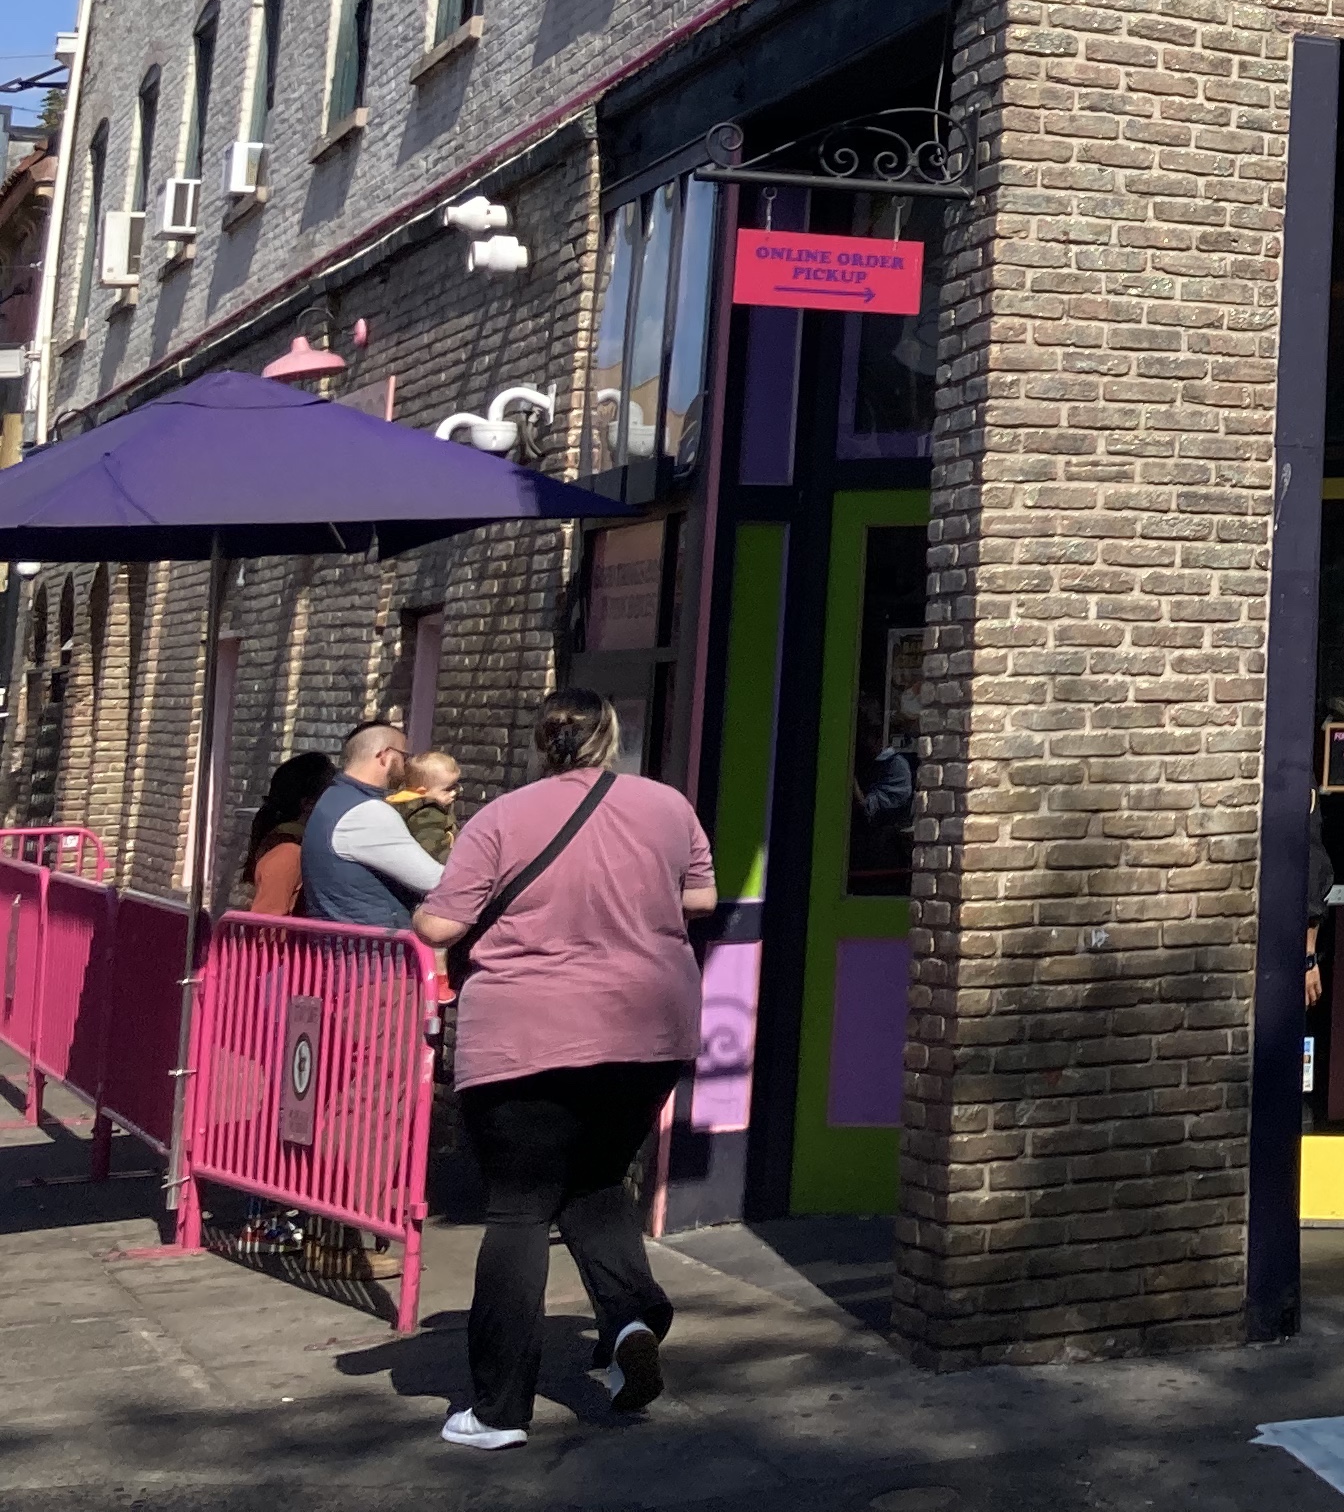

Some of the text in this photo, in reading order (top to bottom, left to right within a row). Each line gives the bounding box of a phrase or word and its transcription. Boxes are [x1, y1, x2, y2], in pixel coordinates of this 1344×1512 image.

[755, 246, 905, 270] ONLINE ORDER
[792, 266, 867, 284] PICKUP
